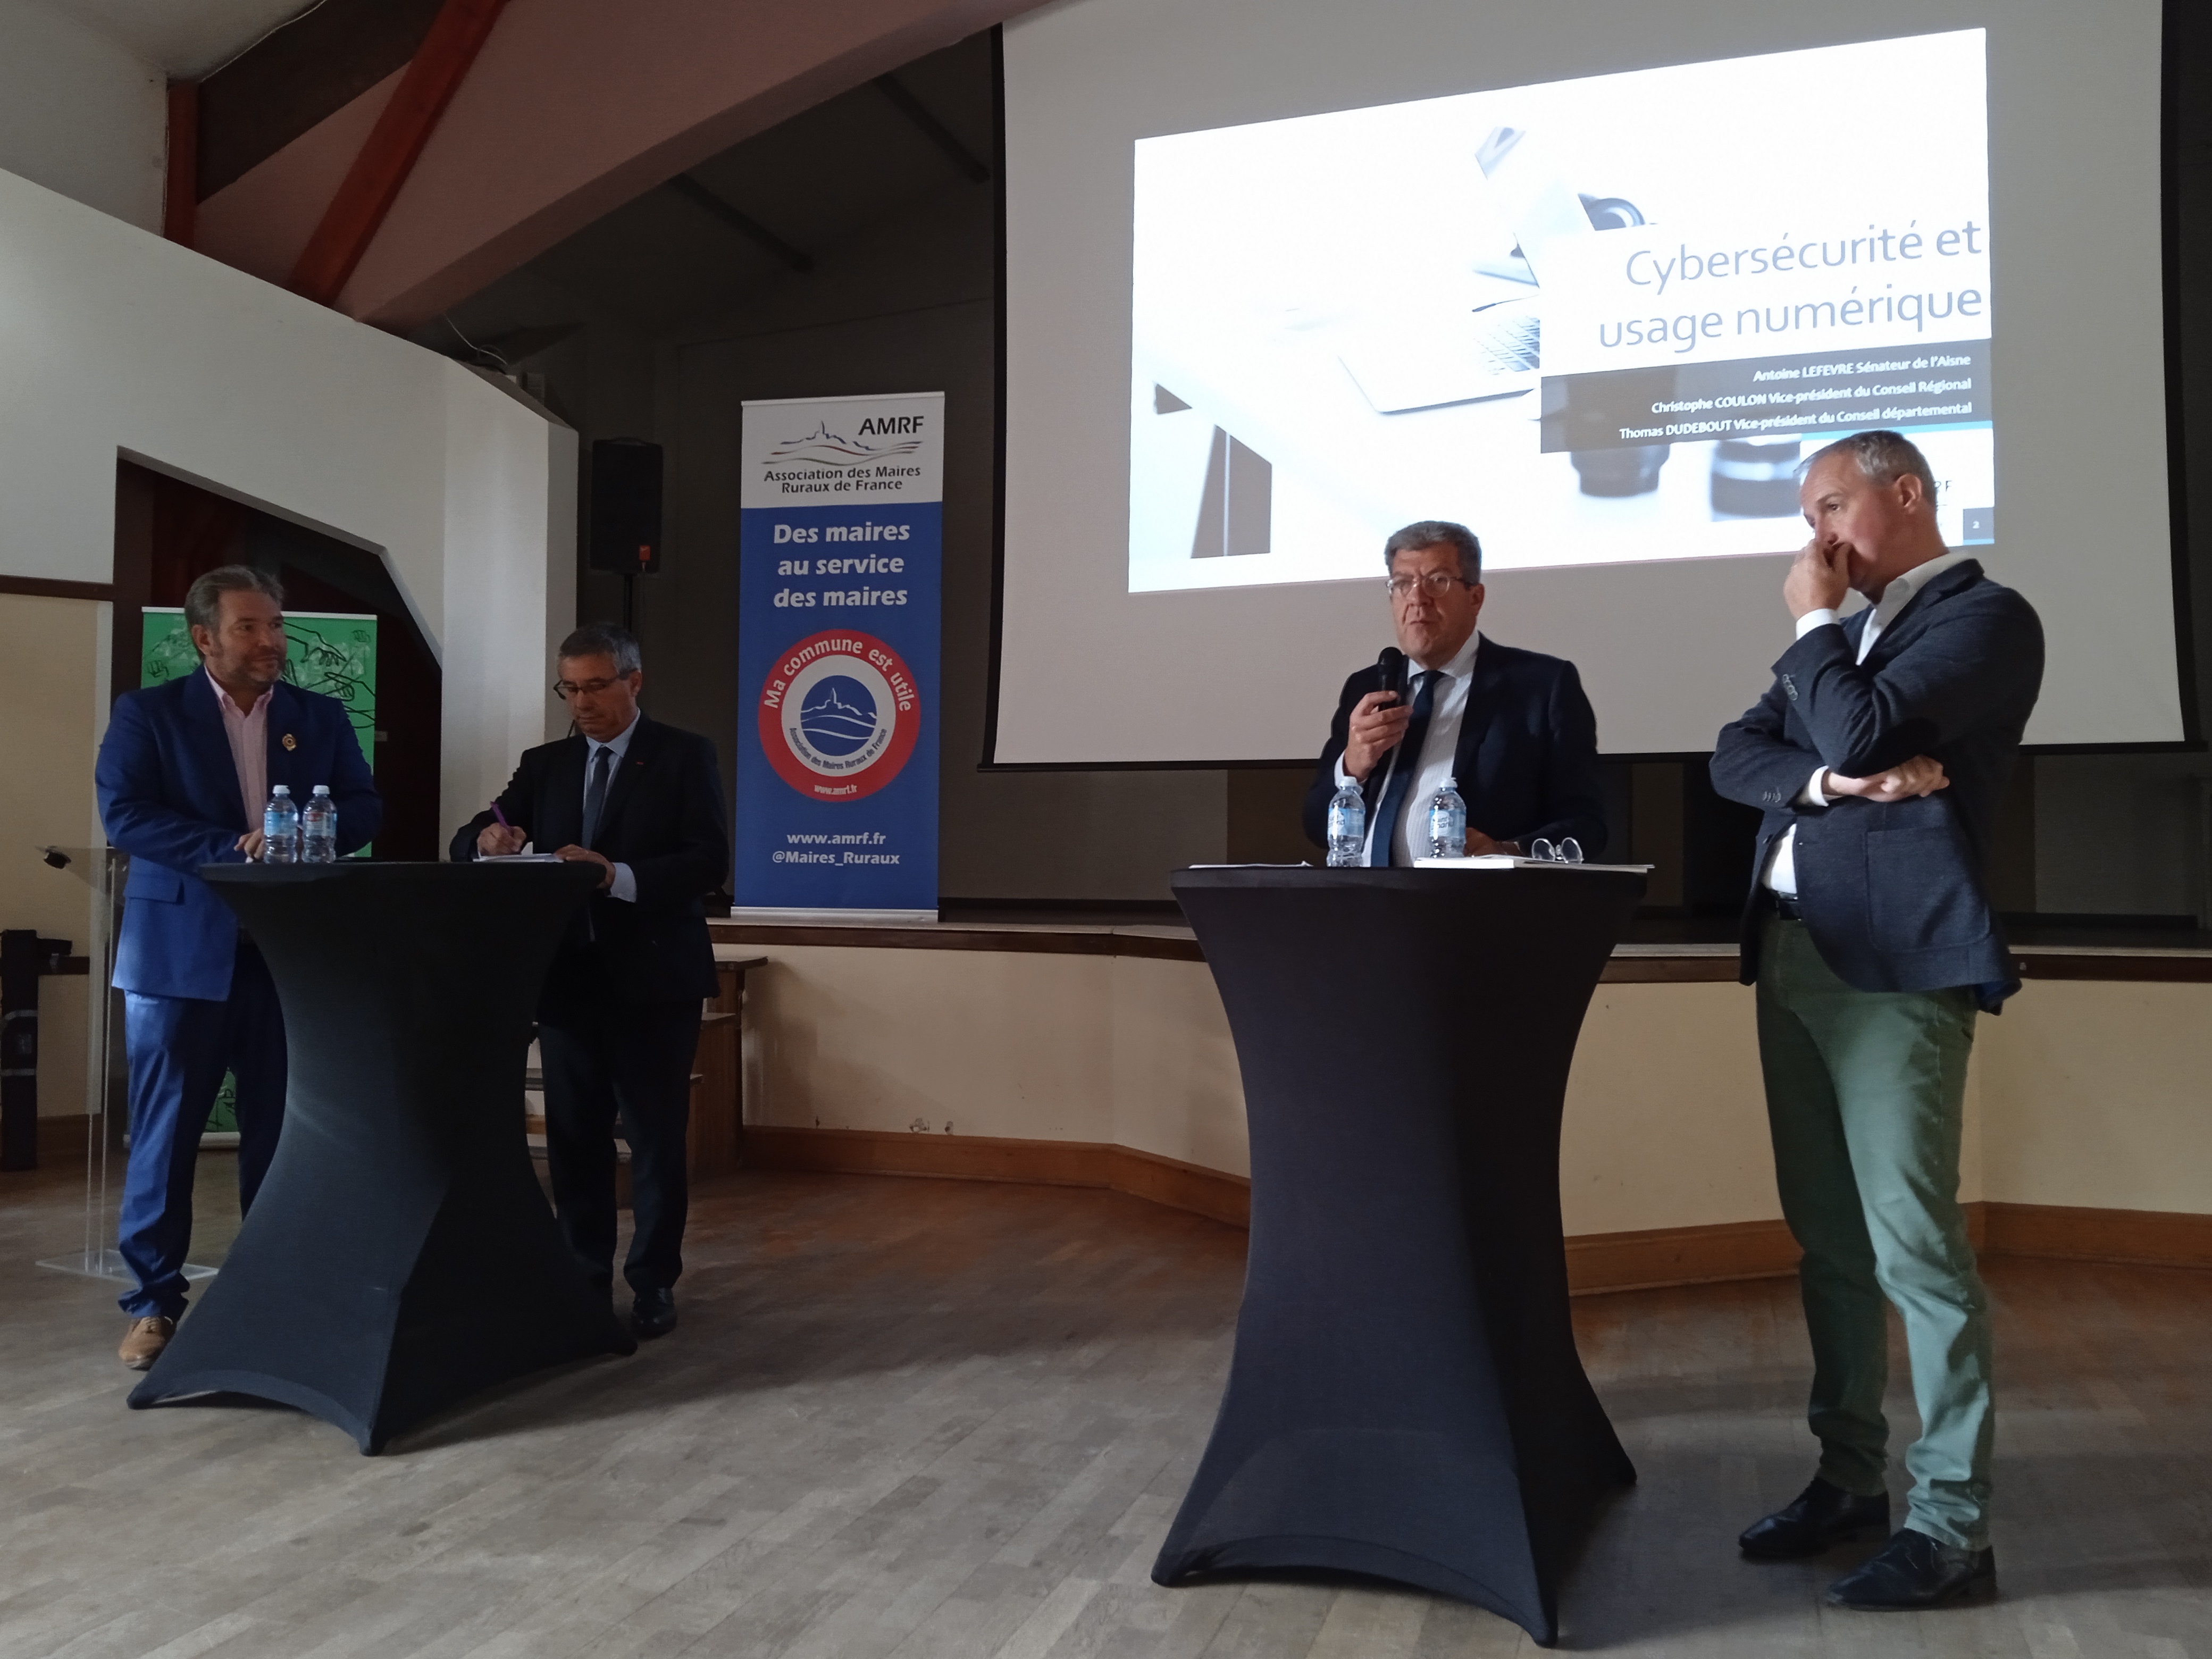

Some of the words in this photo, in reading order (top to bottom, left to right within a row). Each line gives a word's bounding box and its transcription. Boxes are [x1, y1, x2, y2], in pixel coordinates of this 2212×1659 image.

[1626, 220, 1923, 295] Cybersécurité
[1936, 220, 1982, 256] et
[1599, 310, 1723, 354] usage
[1736, 283, 1982, 335] numérique
[1753, 368, 1800, 383] Antoine
[1802, 362, 1855, 379] LEFEVRE
[1856, 358, 1911, 374] Sénateur
[1912, 356, 1929, 368] de
[1651, 398, 1713, 414] Christophe
[1714, 393, 1767, 408] COULON
[1768, 387, 1853, 405] Vice-président
[1854, 385, 1871, 398] du
[1872, 381, 1916, 396] Conseil
[1917, 378, 1972, 395] Régional
[858, 416, 924, 435] AMRF
[1619, 428, 1664, 440] Thomas
[1665, 419, 1732, 436] DUDEBOUT
[1733, 413, 1817, 431] Vice-président
[1818, 412, 1836, 425] du
[1836, 408, 1881, 423] Conseil
[1881, 401, 1973, 421] départemental
[764, 468, 843, 482] Association
[847, 467, 872, 479] des
[875, 465, 921, 478] Maires
[781, 482, 830, 493] Ruraux
[833, 480, 851, 491] de
[856, 479, 903, 491] France
[773, 524, 818, 544] Des
[825, 521, 910, 542] maires
[1972, 520, 1981, 529] 2
[777, 559, 809, 576] au
[816, 554, 904, 574] service
[773, 588, 816, 608] des
[823, 586, 908, 606] maires
[764, 679, 786, 709] Ma
[783, 639, 864, 676] commune
[868, 648, 893, 672] est
[889, 672, 916, 712] utile
[844, 755, 867, 769] Ruraux
[872, 728, 887, 750] France
[787, 833, 886, 845] www.amrf.fr
[772, 851, 900, 866] @Maires_Ruraux
